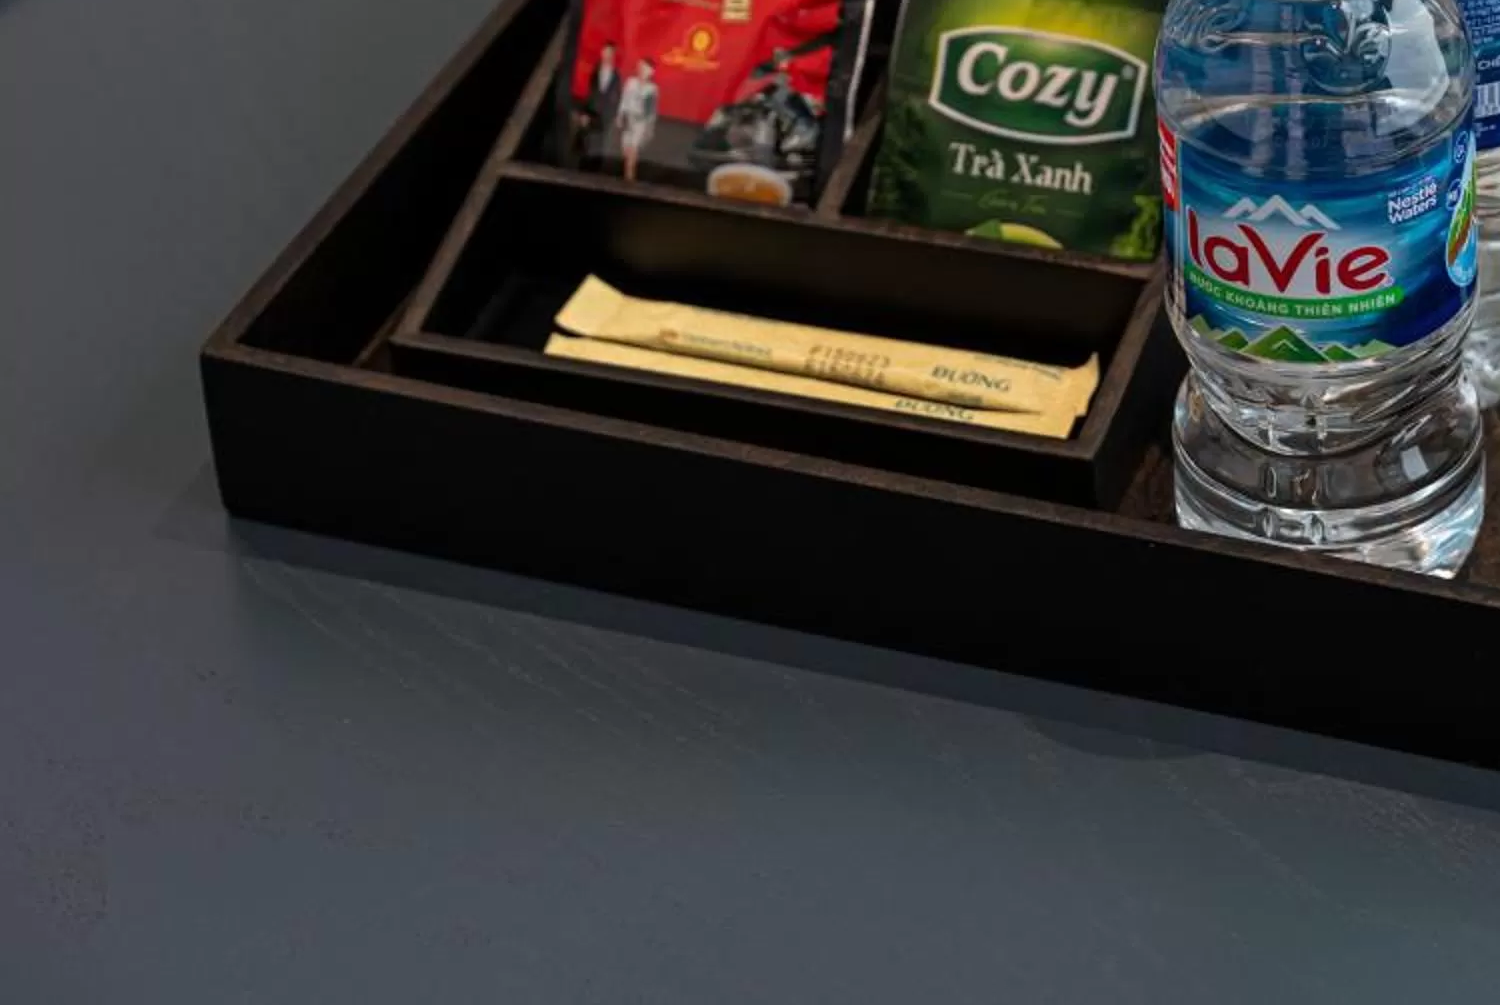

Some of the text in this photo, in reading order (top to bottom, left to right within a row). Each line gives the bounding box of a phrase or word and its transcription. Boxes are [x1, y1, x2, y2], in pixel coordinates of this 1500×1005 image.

[957, 41, 1119, 128] Cozy
[949, 142, 1092, 195] Trà Xanh
[1187, 209, 1390, 295] laVie
